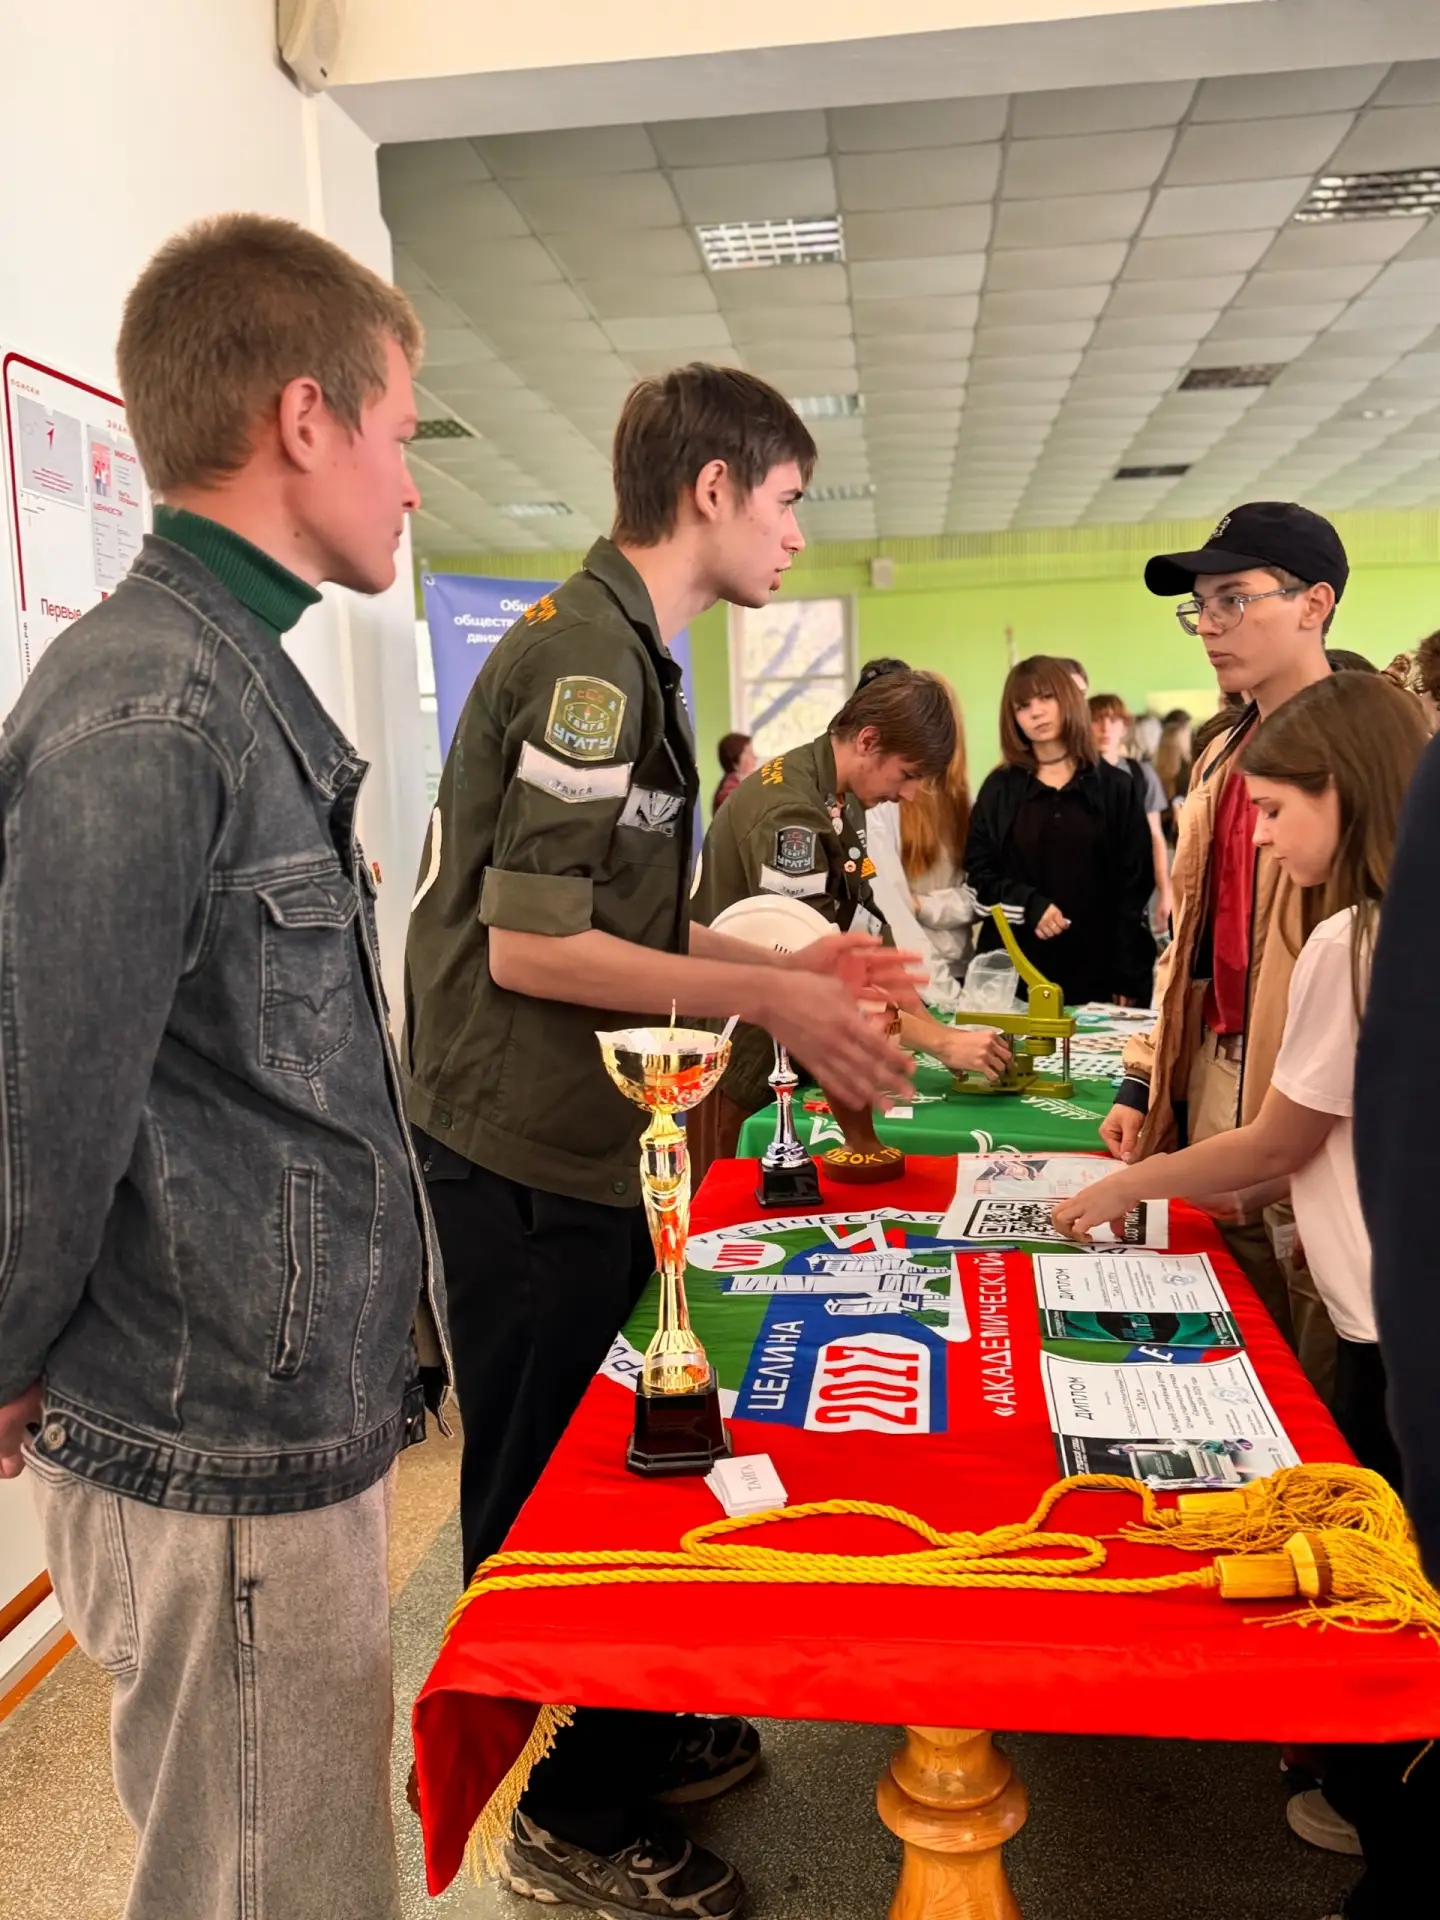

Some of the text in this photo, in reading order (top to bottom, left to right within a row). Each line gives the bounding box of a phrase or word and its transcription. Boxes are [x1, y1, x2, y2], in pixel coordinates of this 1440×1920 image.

[454, 614, 514, 627] обществ
[500, 599, 528, 611] Общ
[692, 1209, 946, 1244] УДЕНЧЕСКАЯ
[712, 1244, 765, 1270] VIII
[1055, 1267, 1075, 1301] ДИПЛОМ
[748, 1320, 804, 1410] ЦЕЛИНА
[815, 1345, 920, 1426] 2017
[1067, 1376, 1095, 1421] ДИПЛОМ
